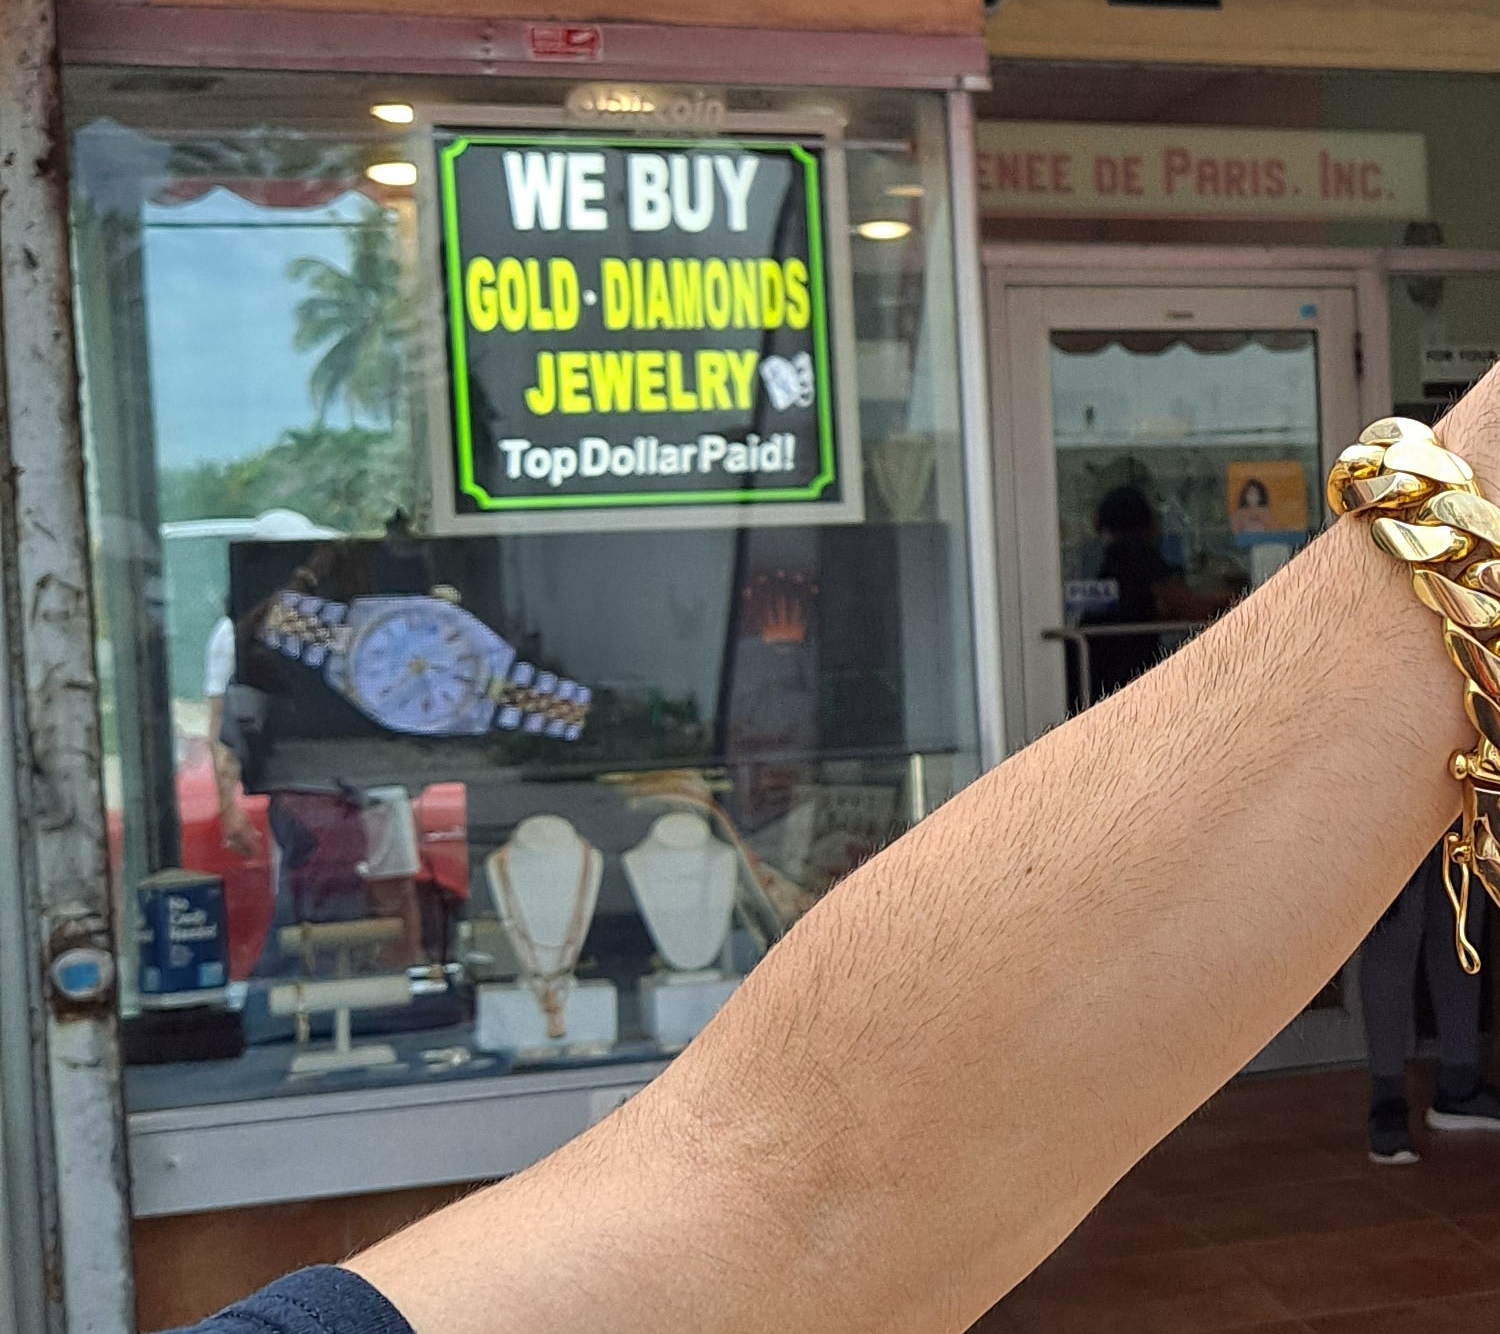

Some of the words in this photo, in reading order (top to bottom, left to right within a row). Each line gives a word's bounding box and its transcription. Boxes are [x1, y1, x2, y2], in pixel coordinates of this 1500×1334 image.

[503, 151, 609, 231] WE
[627, 153, 760, 233] BUY
[466, 256, 580, 333] GOLD
[601, 257, 811, 330] DIAMONDS
[525, 349, 759, 415] JEWELRY
